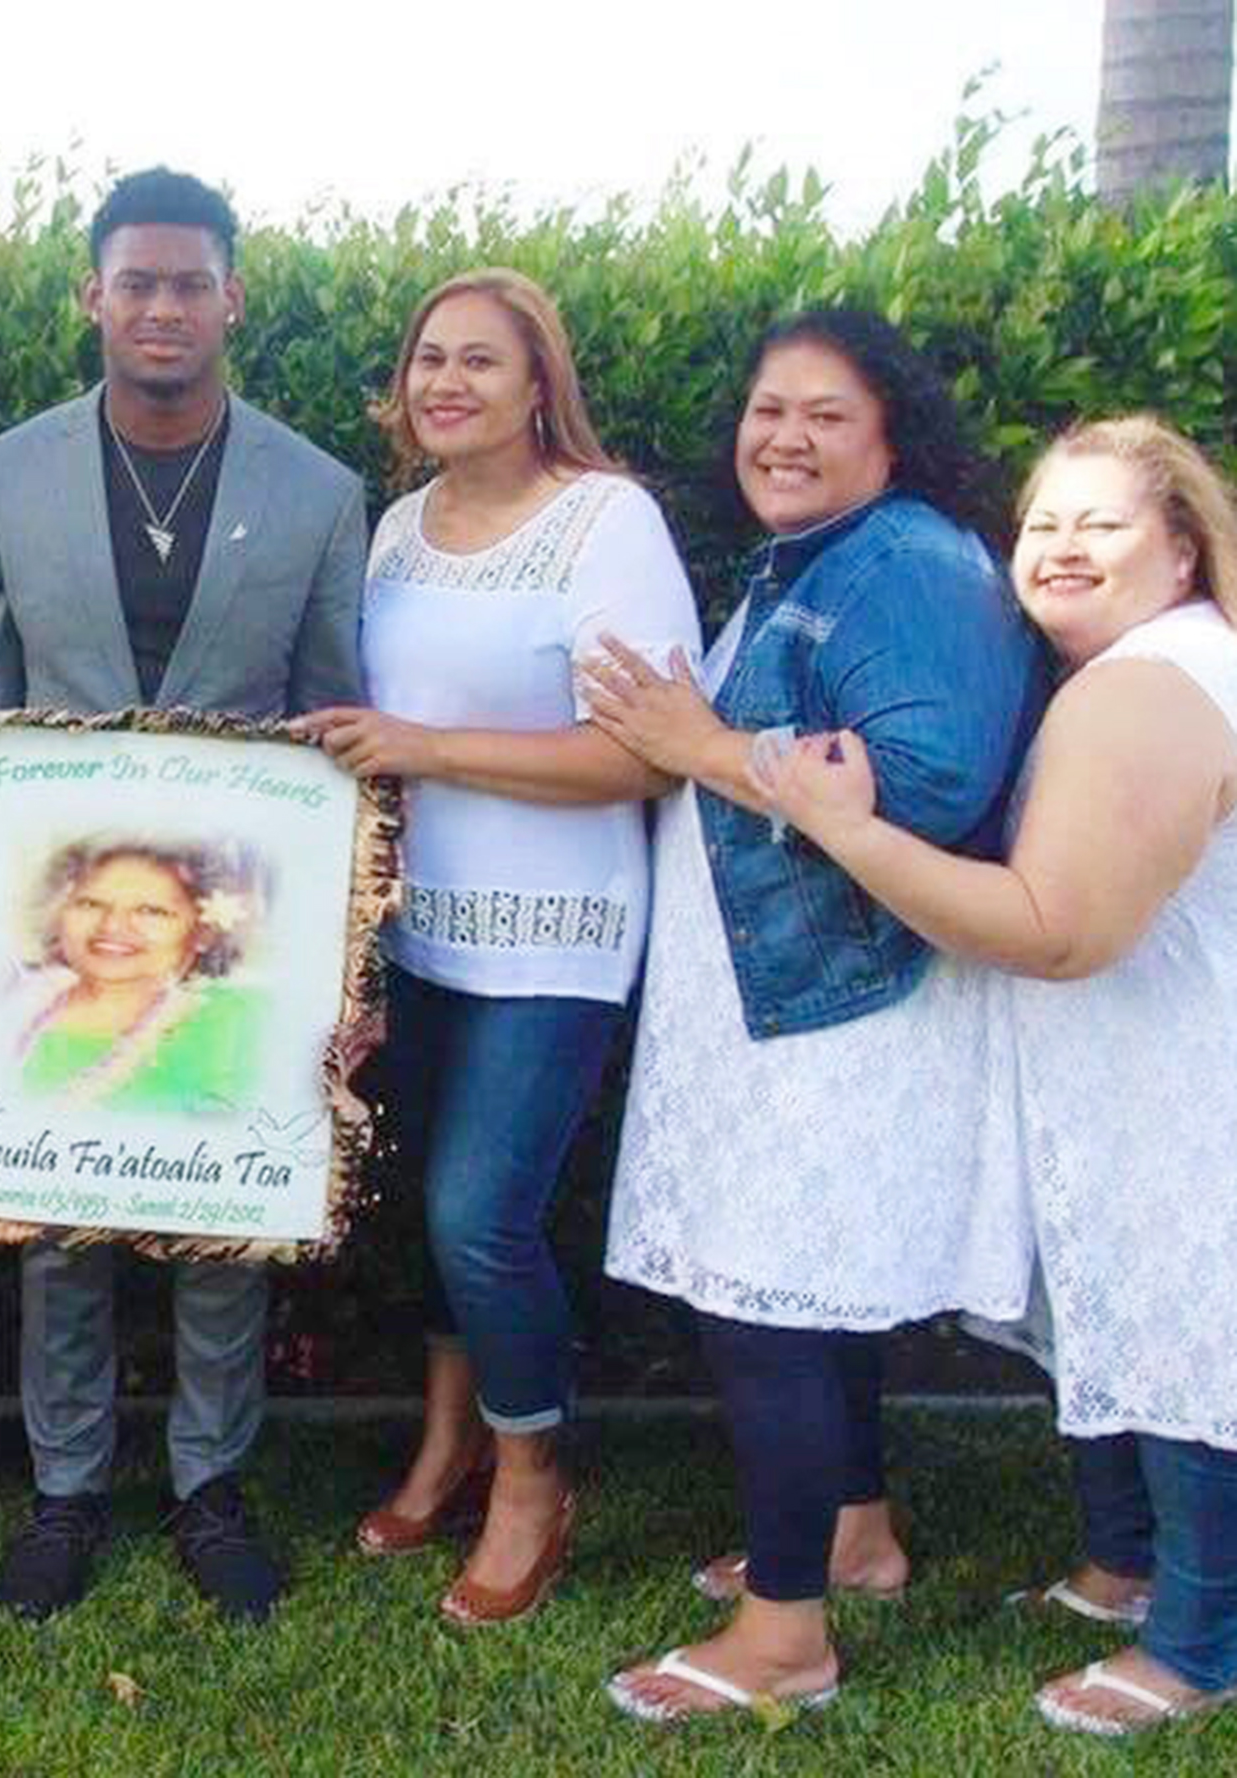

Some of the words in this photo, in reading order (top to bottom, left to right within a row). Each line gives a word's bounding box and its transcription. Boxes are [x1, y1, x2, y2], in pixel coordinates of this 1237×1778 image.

[112, 754, 149, 782] In
[160, 755, 219, 787] Our
[69, 1138, 223, 1188] Fa'atoalia
[234, 1150, 293, 1189] Toa
